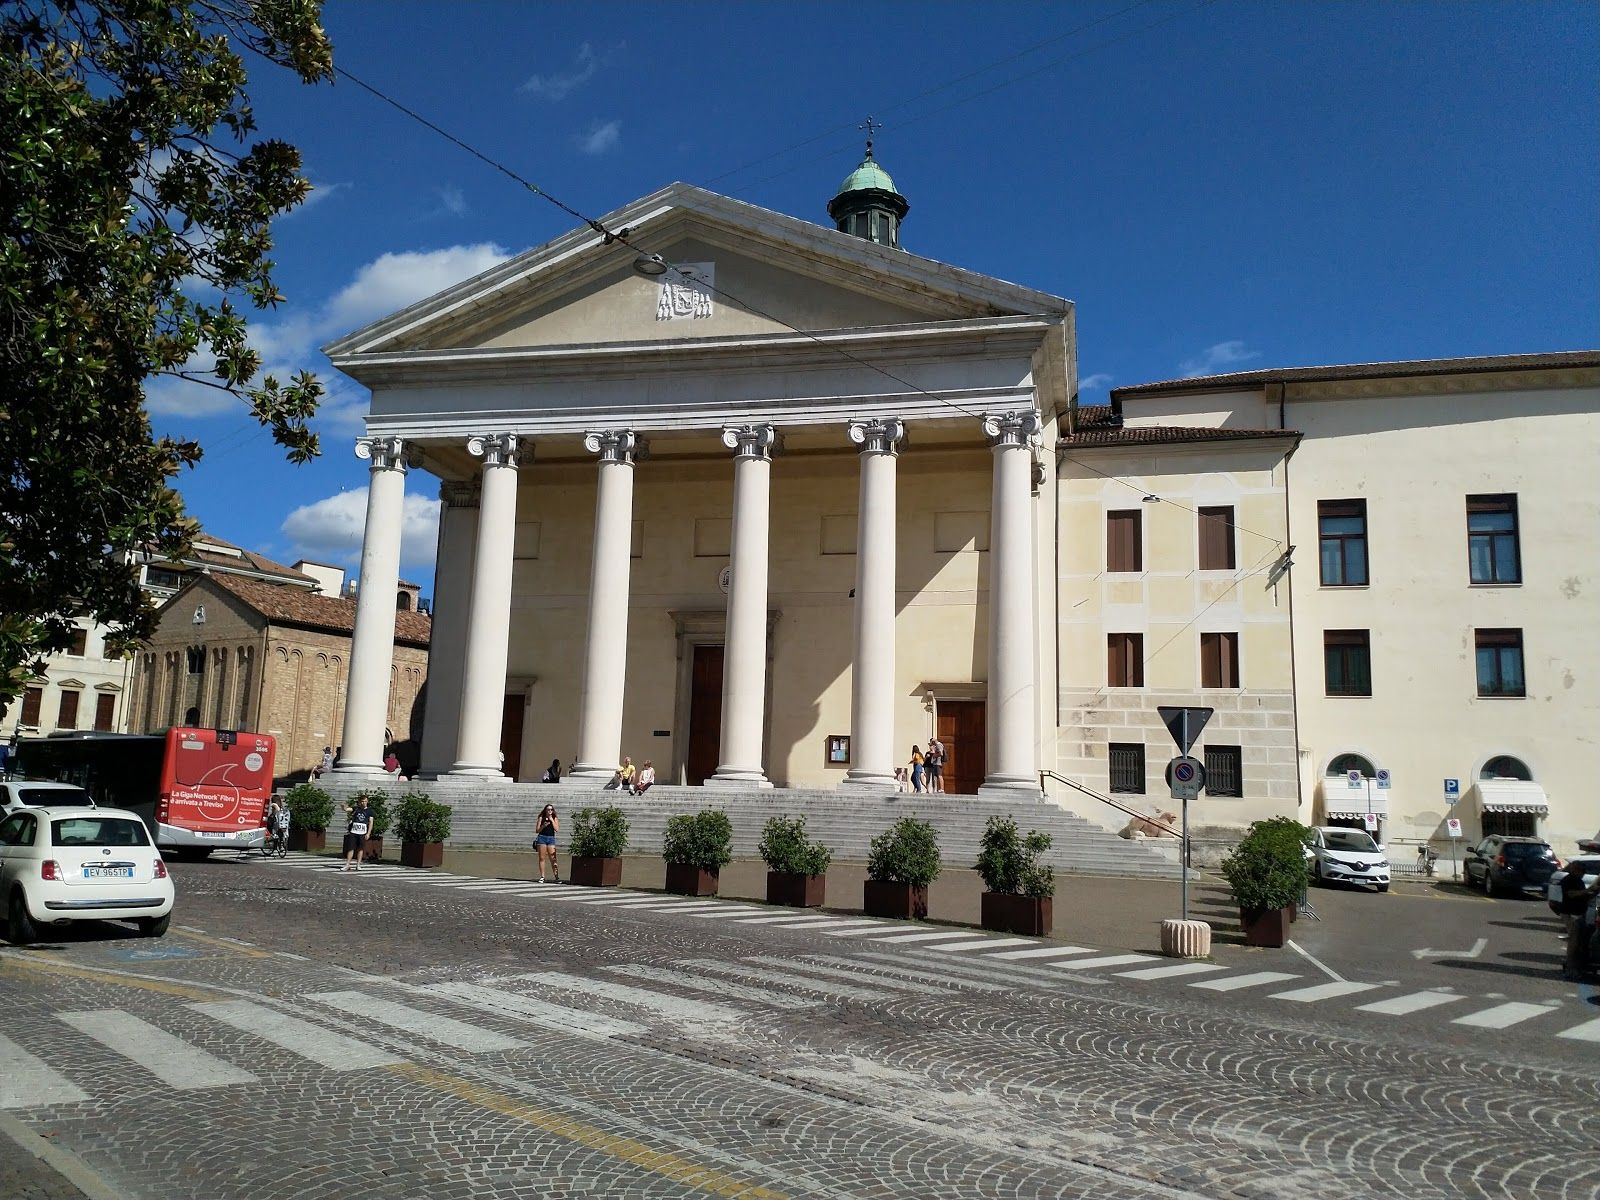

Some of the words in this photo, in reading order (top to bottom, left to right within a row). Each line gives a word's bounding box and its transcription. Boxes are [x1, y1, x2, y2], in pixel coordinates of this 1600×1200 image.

[1446, 780, 1457, 792] P
[174, 798, 198, 806] arrivata
[203, 800, 224, 808] Treviso
[219, 794, 235, 802] Fibra
